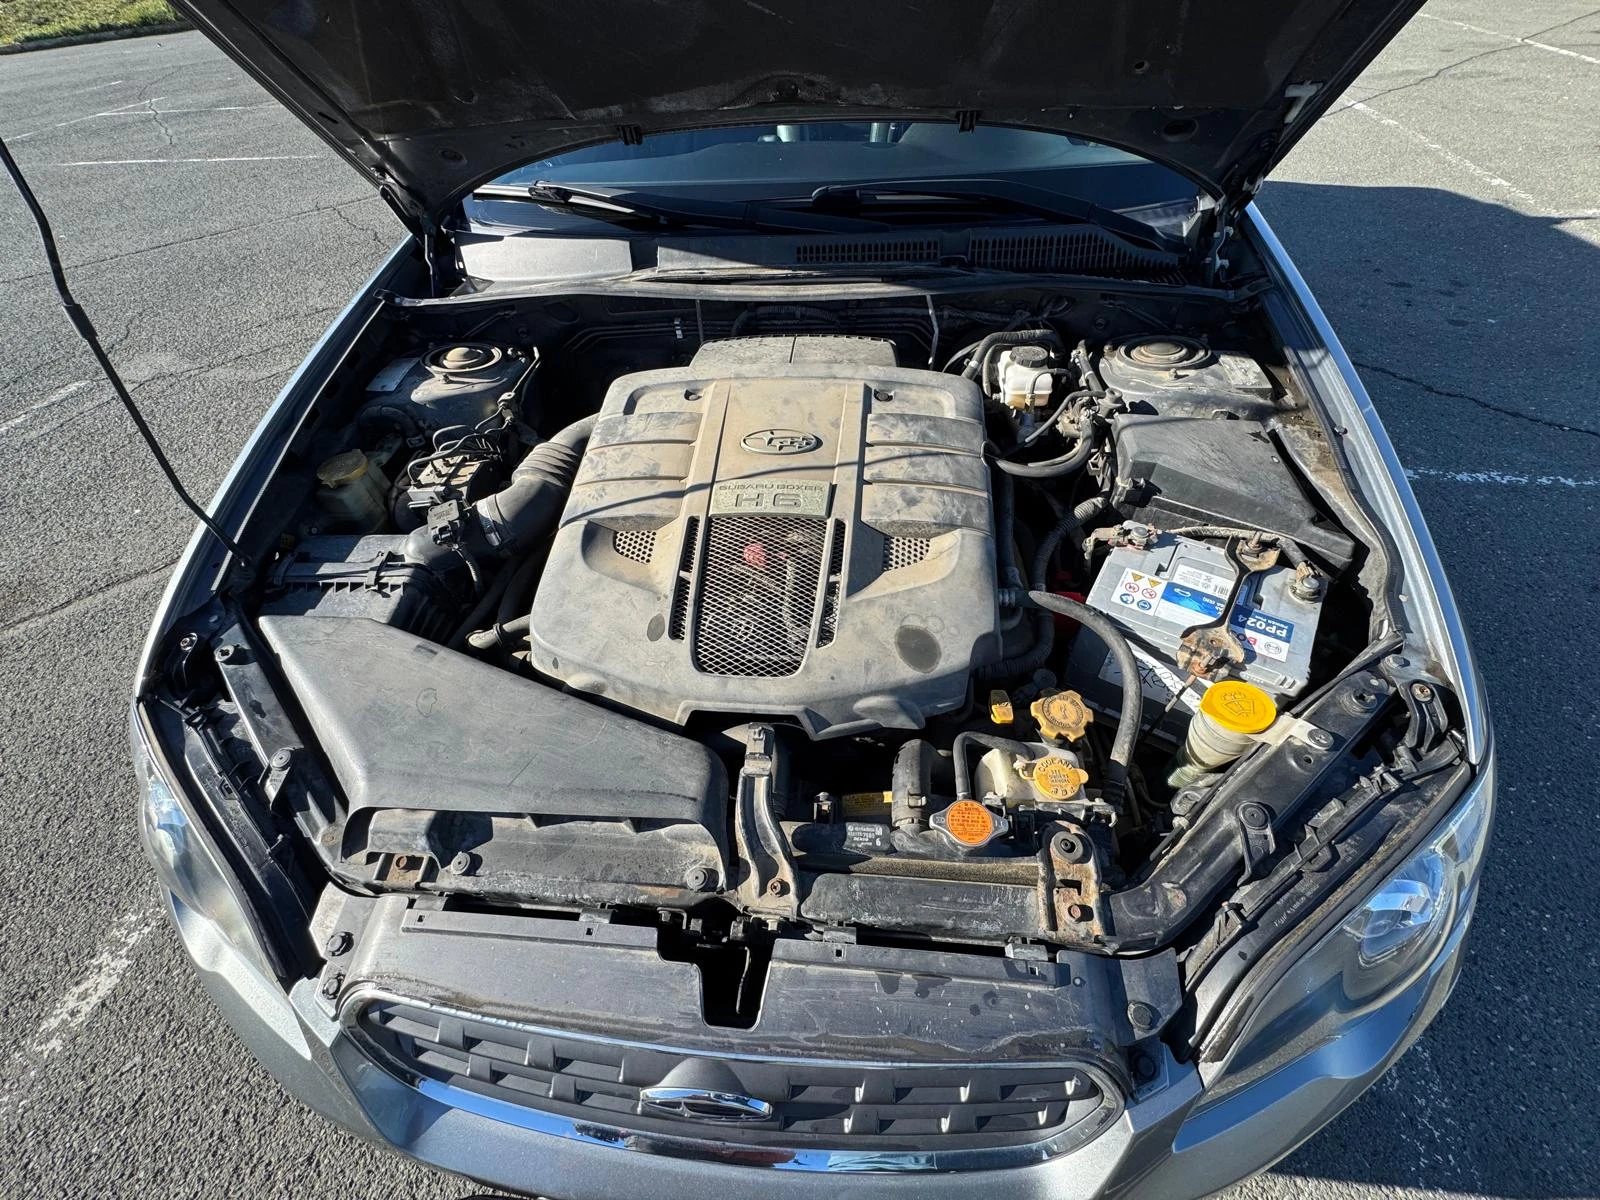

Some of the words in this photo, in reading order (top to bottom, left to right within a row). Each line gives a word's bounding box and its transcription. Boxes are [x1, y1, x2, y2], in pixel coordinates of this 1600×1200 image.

[735, 493, 801, 507] H6
[1238, 614, 1288, 637] PP024
[1038, 758, 1073, 772] COOLANT
